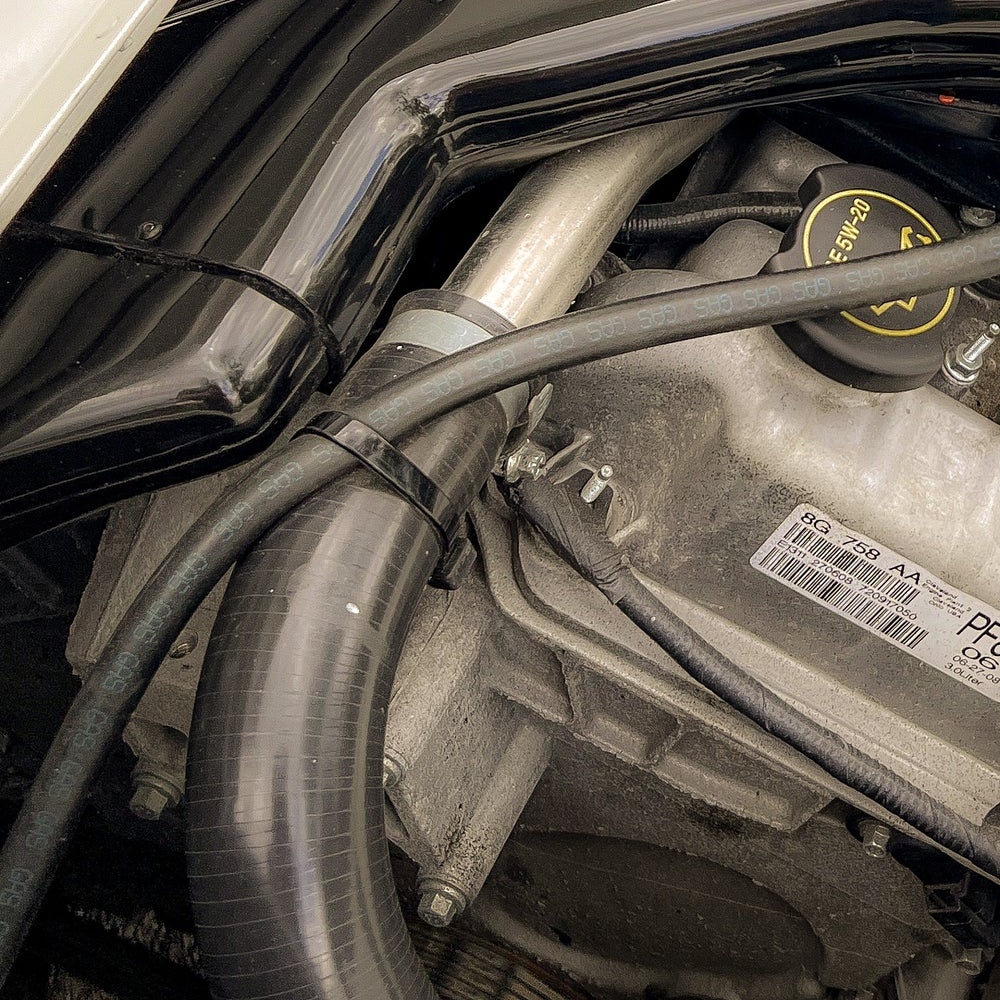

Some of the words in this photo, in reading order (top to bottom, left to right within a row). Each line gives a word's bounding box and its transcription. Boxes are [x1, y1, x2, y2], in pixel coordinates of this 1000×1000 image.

[835, 198, 871, 251] 5W-20
[800, 512, 832, 536] 8G
[842, 535, 880, 561] 758
[889, 563, 921, 586] AA
[961, 646, 1000, 671] 06
